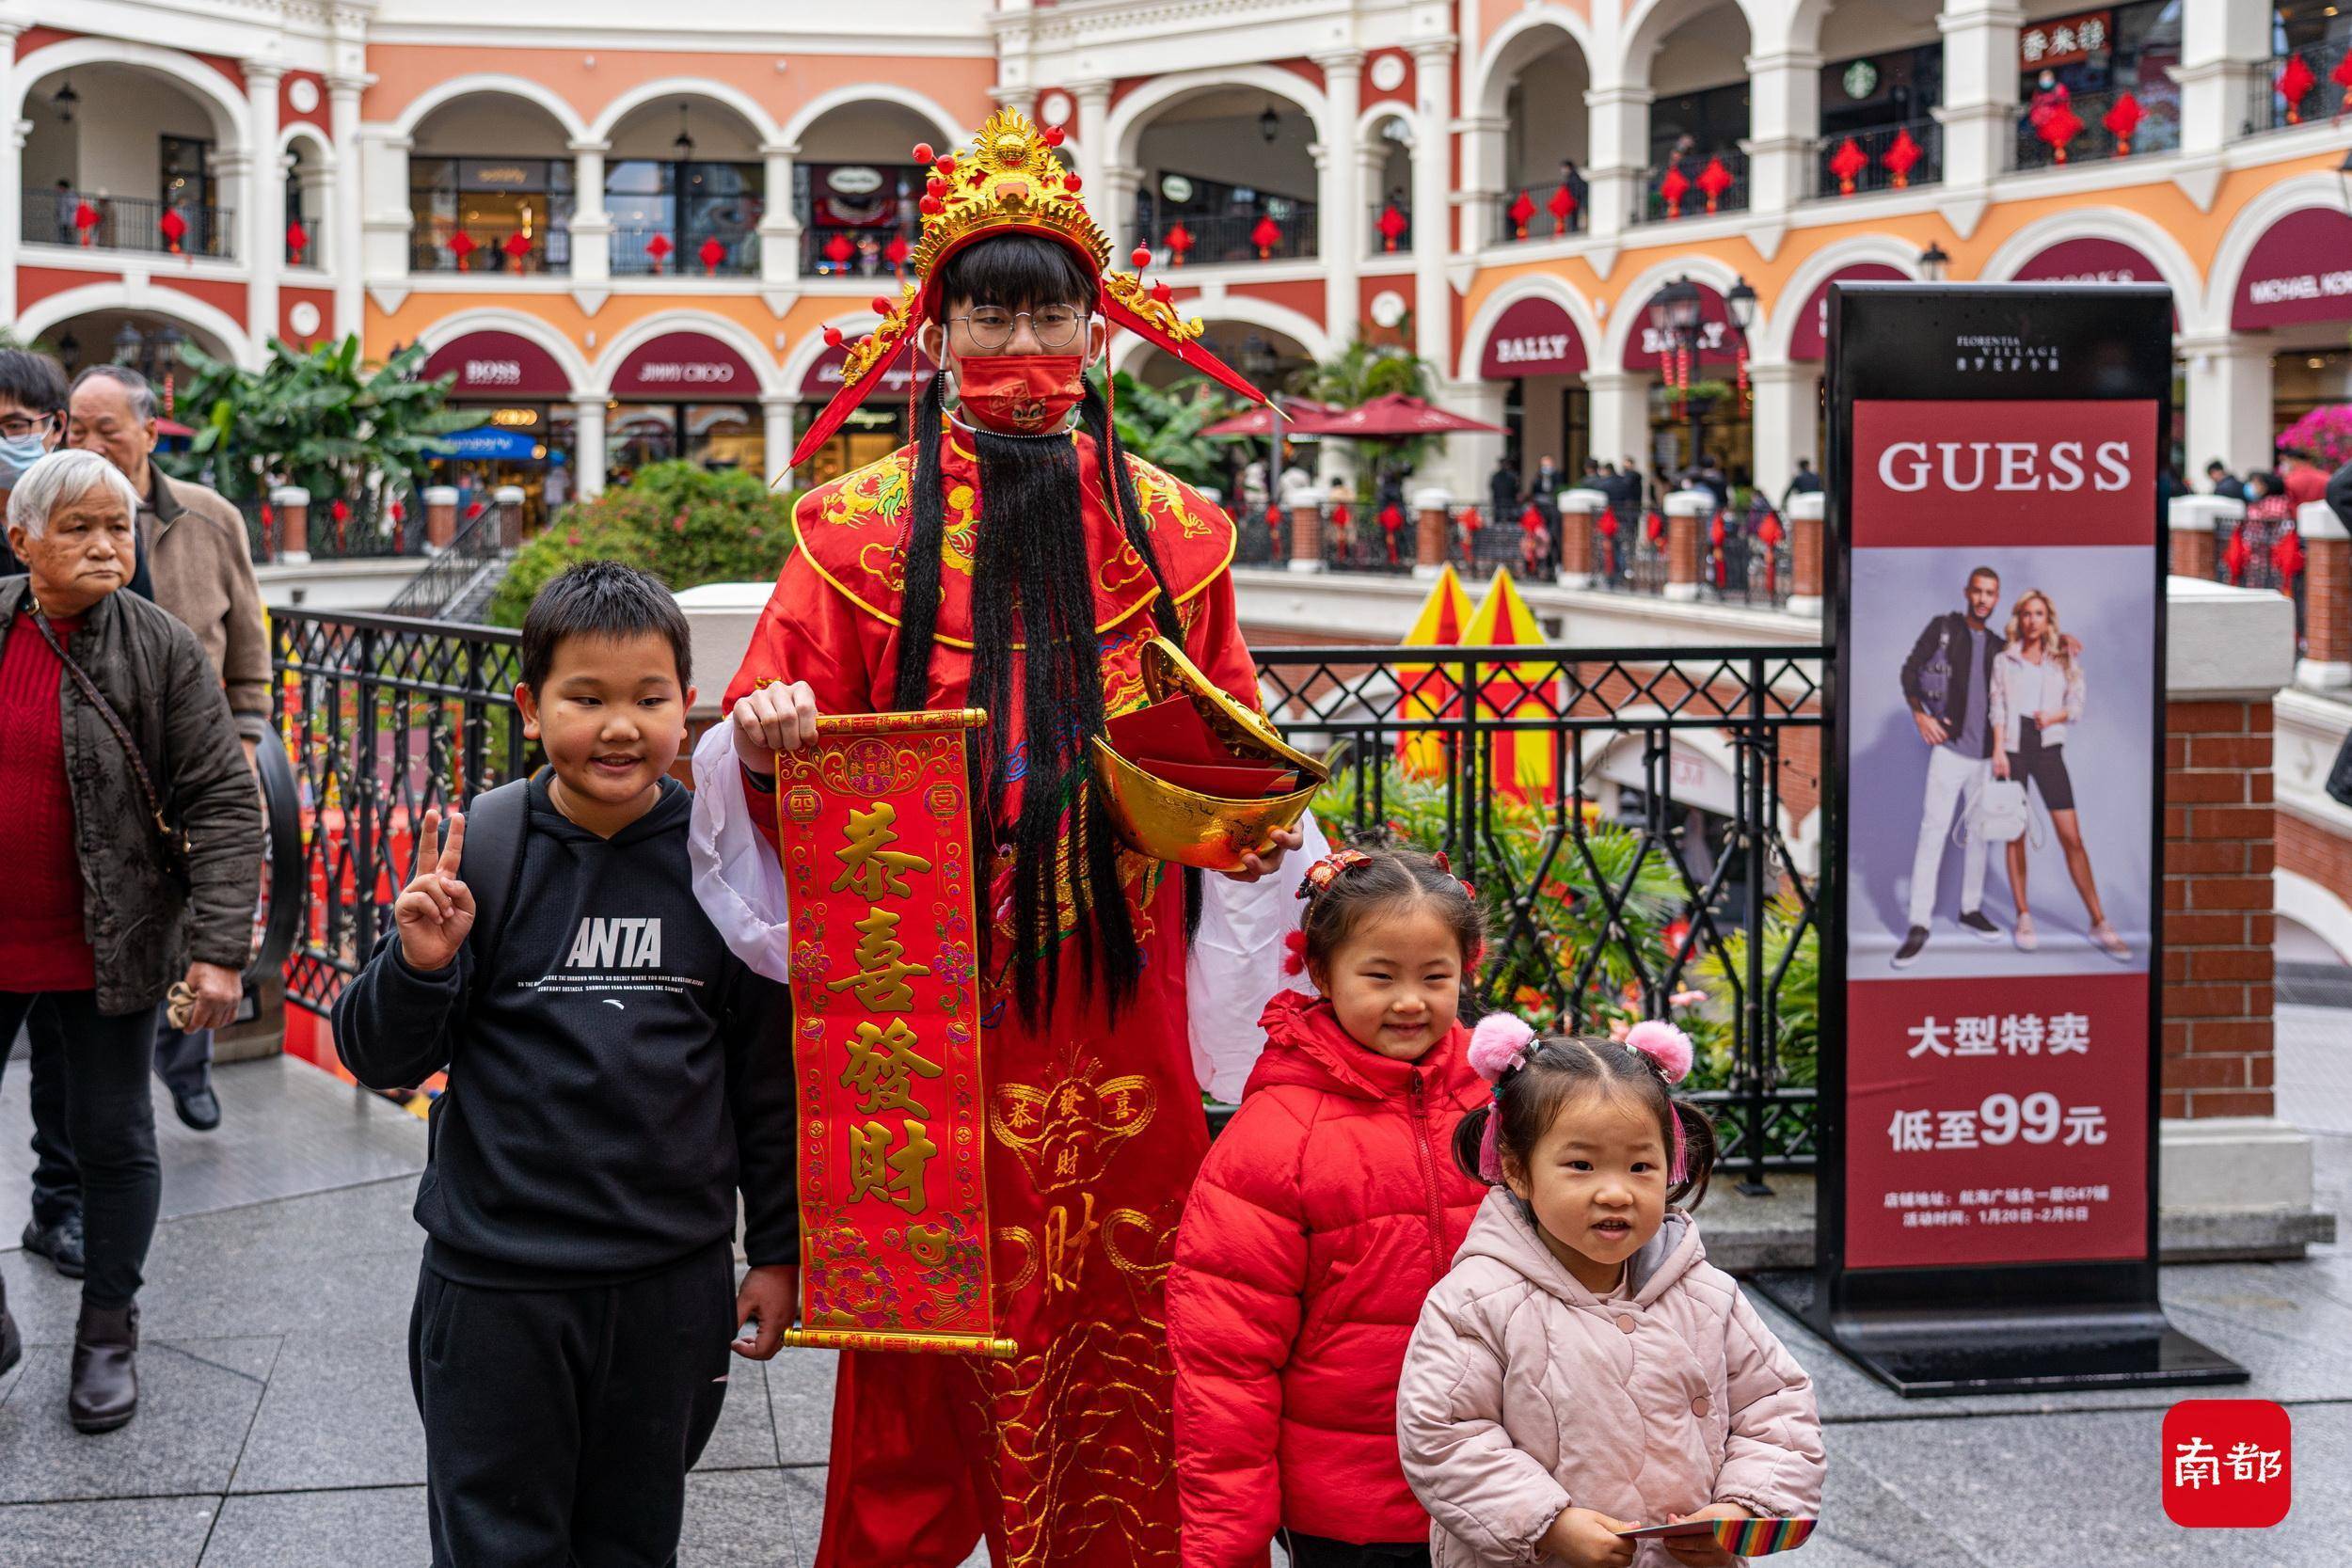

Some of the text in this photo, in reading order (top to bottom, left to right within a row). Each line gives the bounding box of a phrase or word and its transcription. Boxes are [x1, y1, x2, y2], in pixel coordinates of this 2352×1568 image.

[2250, 275, 2319, 304] MICHAEL
[1497, 335, 1569, 362] BALLY
[1957, 336, 2020, 346] FLORENTIA
[1981, 346, 2058, 356] VILLAGE
[466, 360, 520, 379] BOSS
[639, 362, 681, 381] JIMMY
[1878, 441, 2132, 492] GUESS
[565, 917, 661, 968] ANTA
[1906, 1012, 2090, 1058] 大型特卖
[1887, 1092, 2108, 1152] 低至99元
